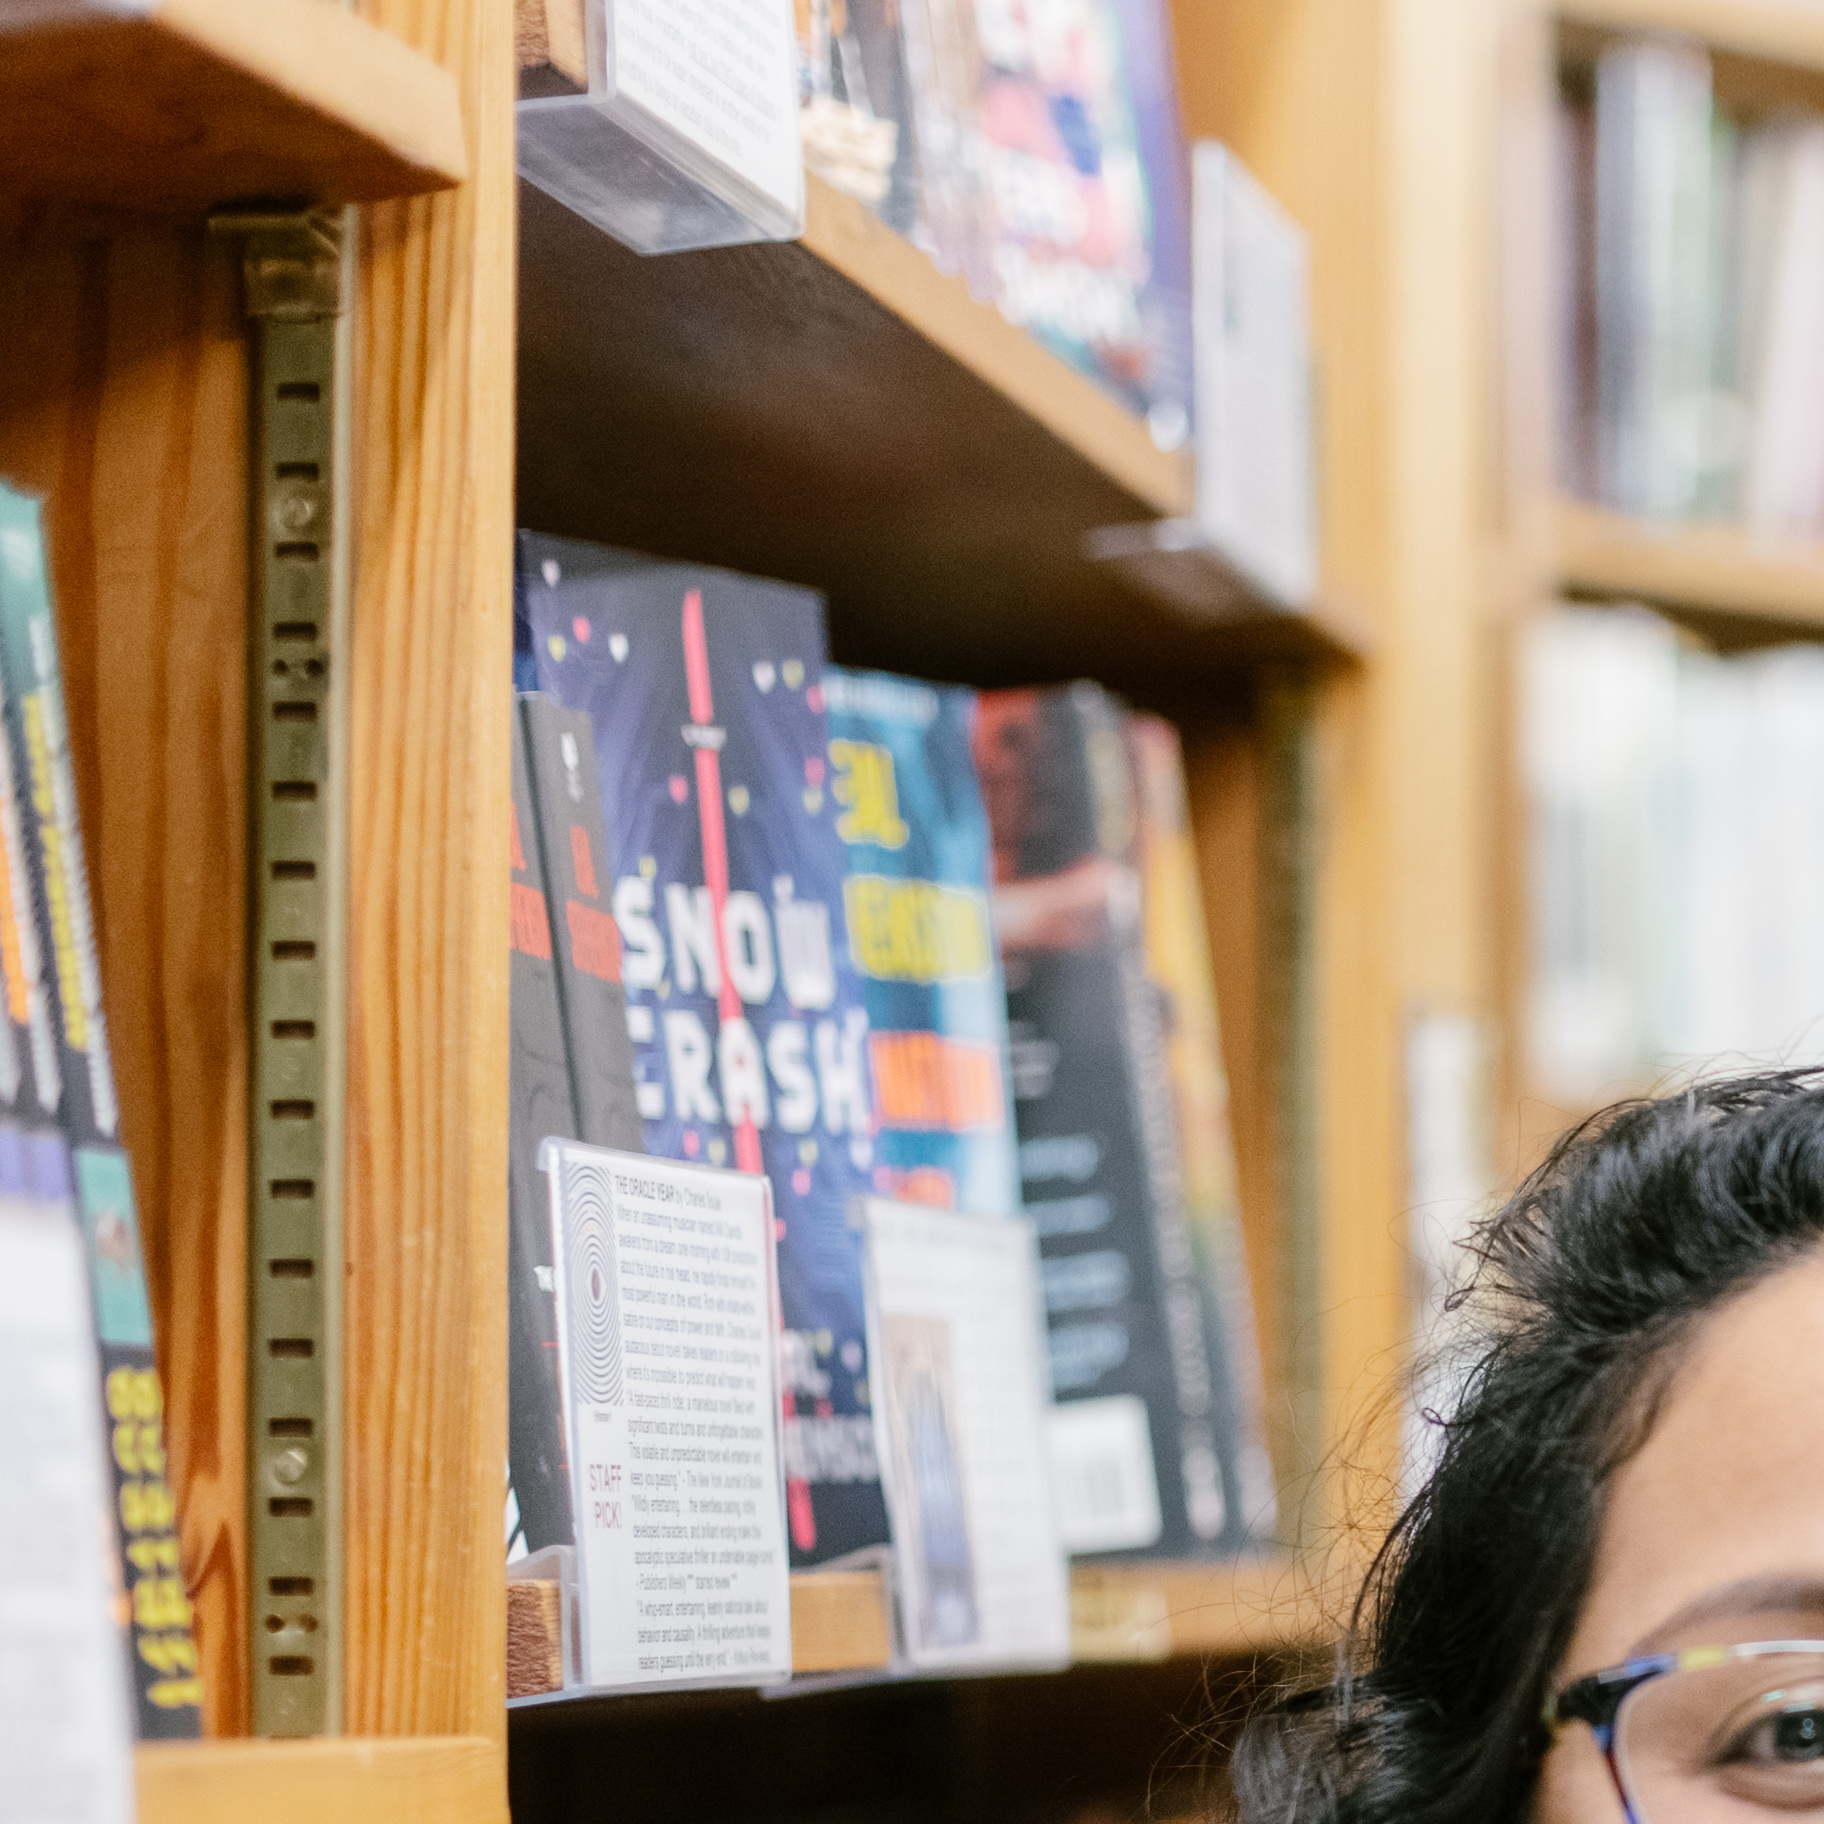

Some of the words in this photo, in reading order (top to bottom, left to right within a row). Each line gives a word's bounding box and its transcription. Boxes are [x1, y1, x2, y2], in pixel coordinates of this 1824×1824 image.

[614, 875, 836, 1010] SNOW
[615, 1175, 629, 1196] THE
[630, 1179, 656, 1201] ORACLE
[657, 1183, 675, 1203] YEAR
[589, 1465, 622, 1492] STAFF
[595, 1501, 622, 1529] PICK!
